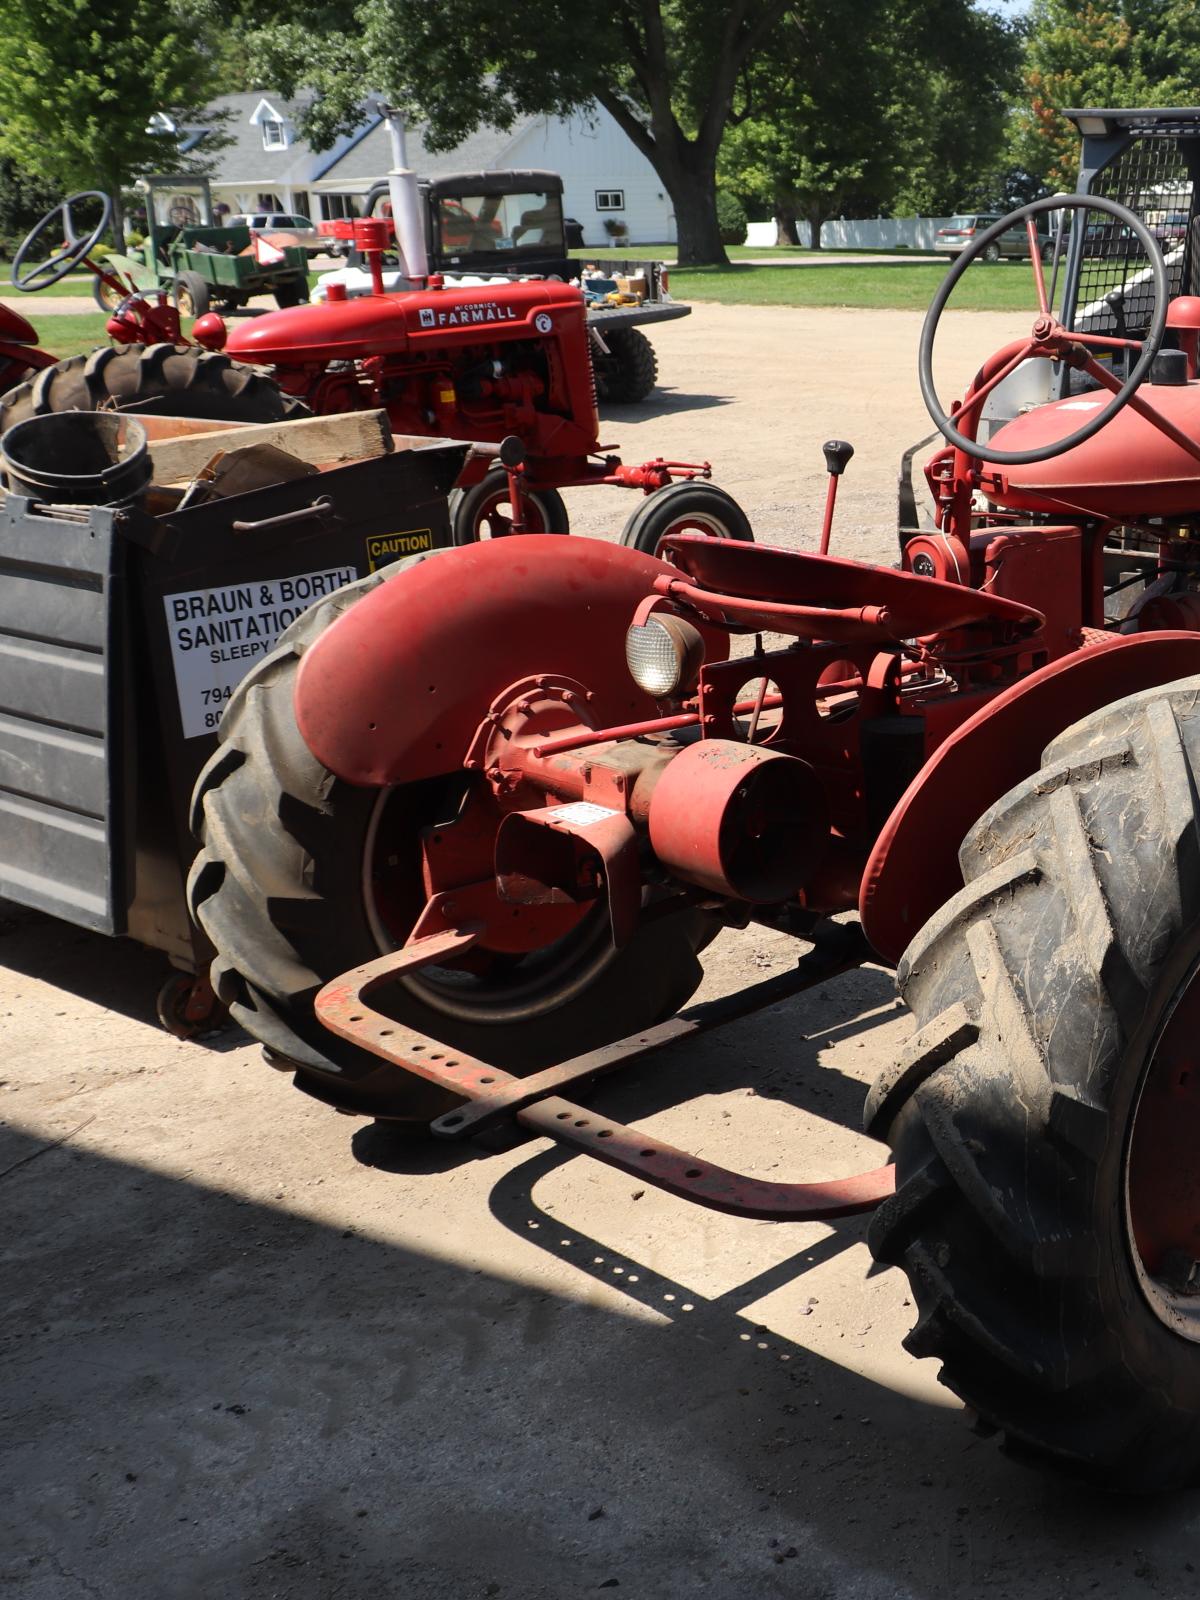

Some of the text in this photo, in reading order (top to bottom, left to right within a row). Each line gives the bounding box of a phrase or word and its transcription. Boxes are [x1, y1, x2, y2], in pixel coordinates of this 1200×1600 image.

[438, 307, 517, 325] FARMALL
[371, 535, 429, 556] CAUTION
[173, 570, 352, 622] BRAUN & BORTH
[210, 640, 270, 664] SLEEPY
